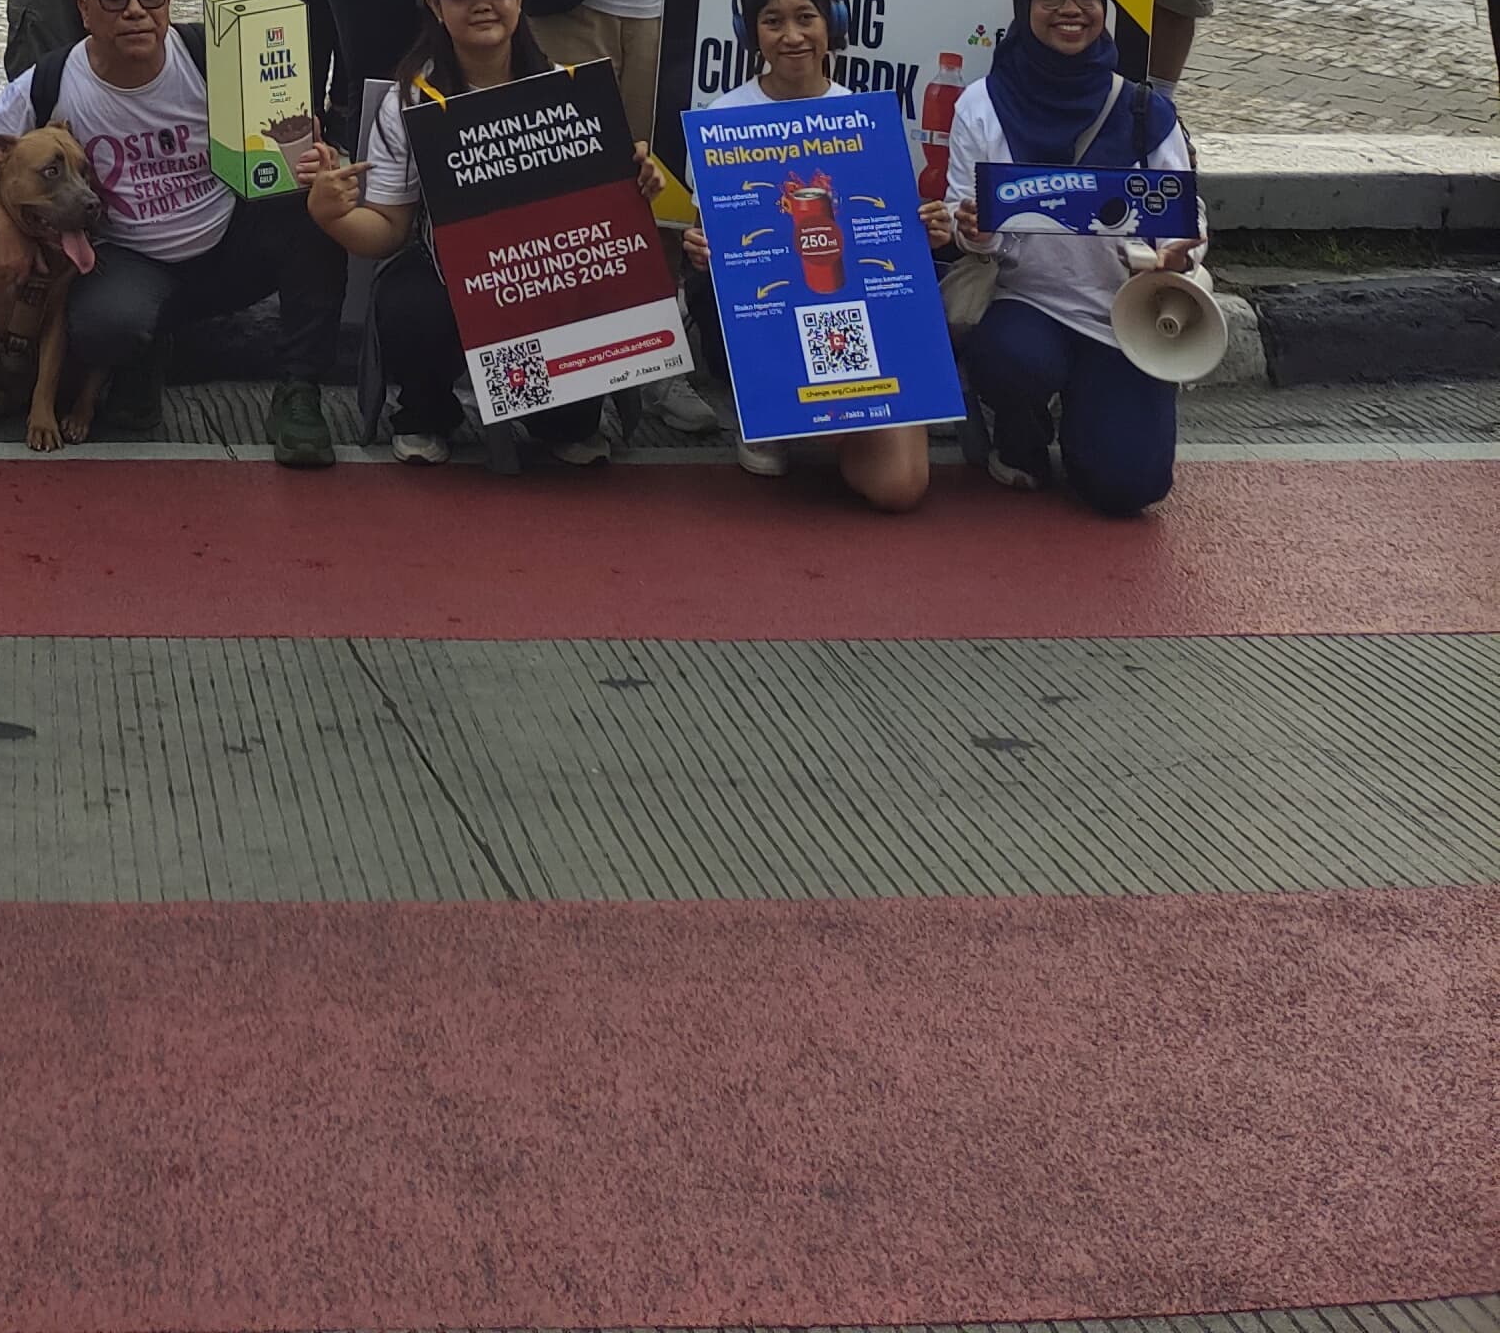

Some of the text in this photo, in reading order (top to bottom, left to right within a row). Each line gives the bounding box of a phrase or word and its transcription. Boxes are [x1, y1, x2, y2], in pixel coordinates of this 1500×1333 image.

[260, 49, 291, 66] ULTI
[260, 63, 298, 83] MILK
[459, 102, 579, 145] MAKIN LAMA
[699, 110, 876, 146] Minumnya Murah,
[124, 125, 190, 161] STOP
[447, 116, 602, 170] CUKAI MINUMAN
[704, 134, 864, 167] Risikonya Mahal
[455, 137, 603, 187] MANIS DITUNDA
[999, 173, 1097, 201] OREORE
[138, 192, 181, 220] PADA
[488, 220, 613, 267] MAKIN CEPAT
[464, 235, 648, 294] MENUJU INDONESIA
[494, 260, 628, 307] (C)EMAS 2045
